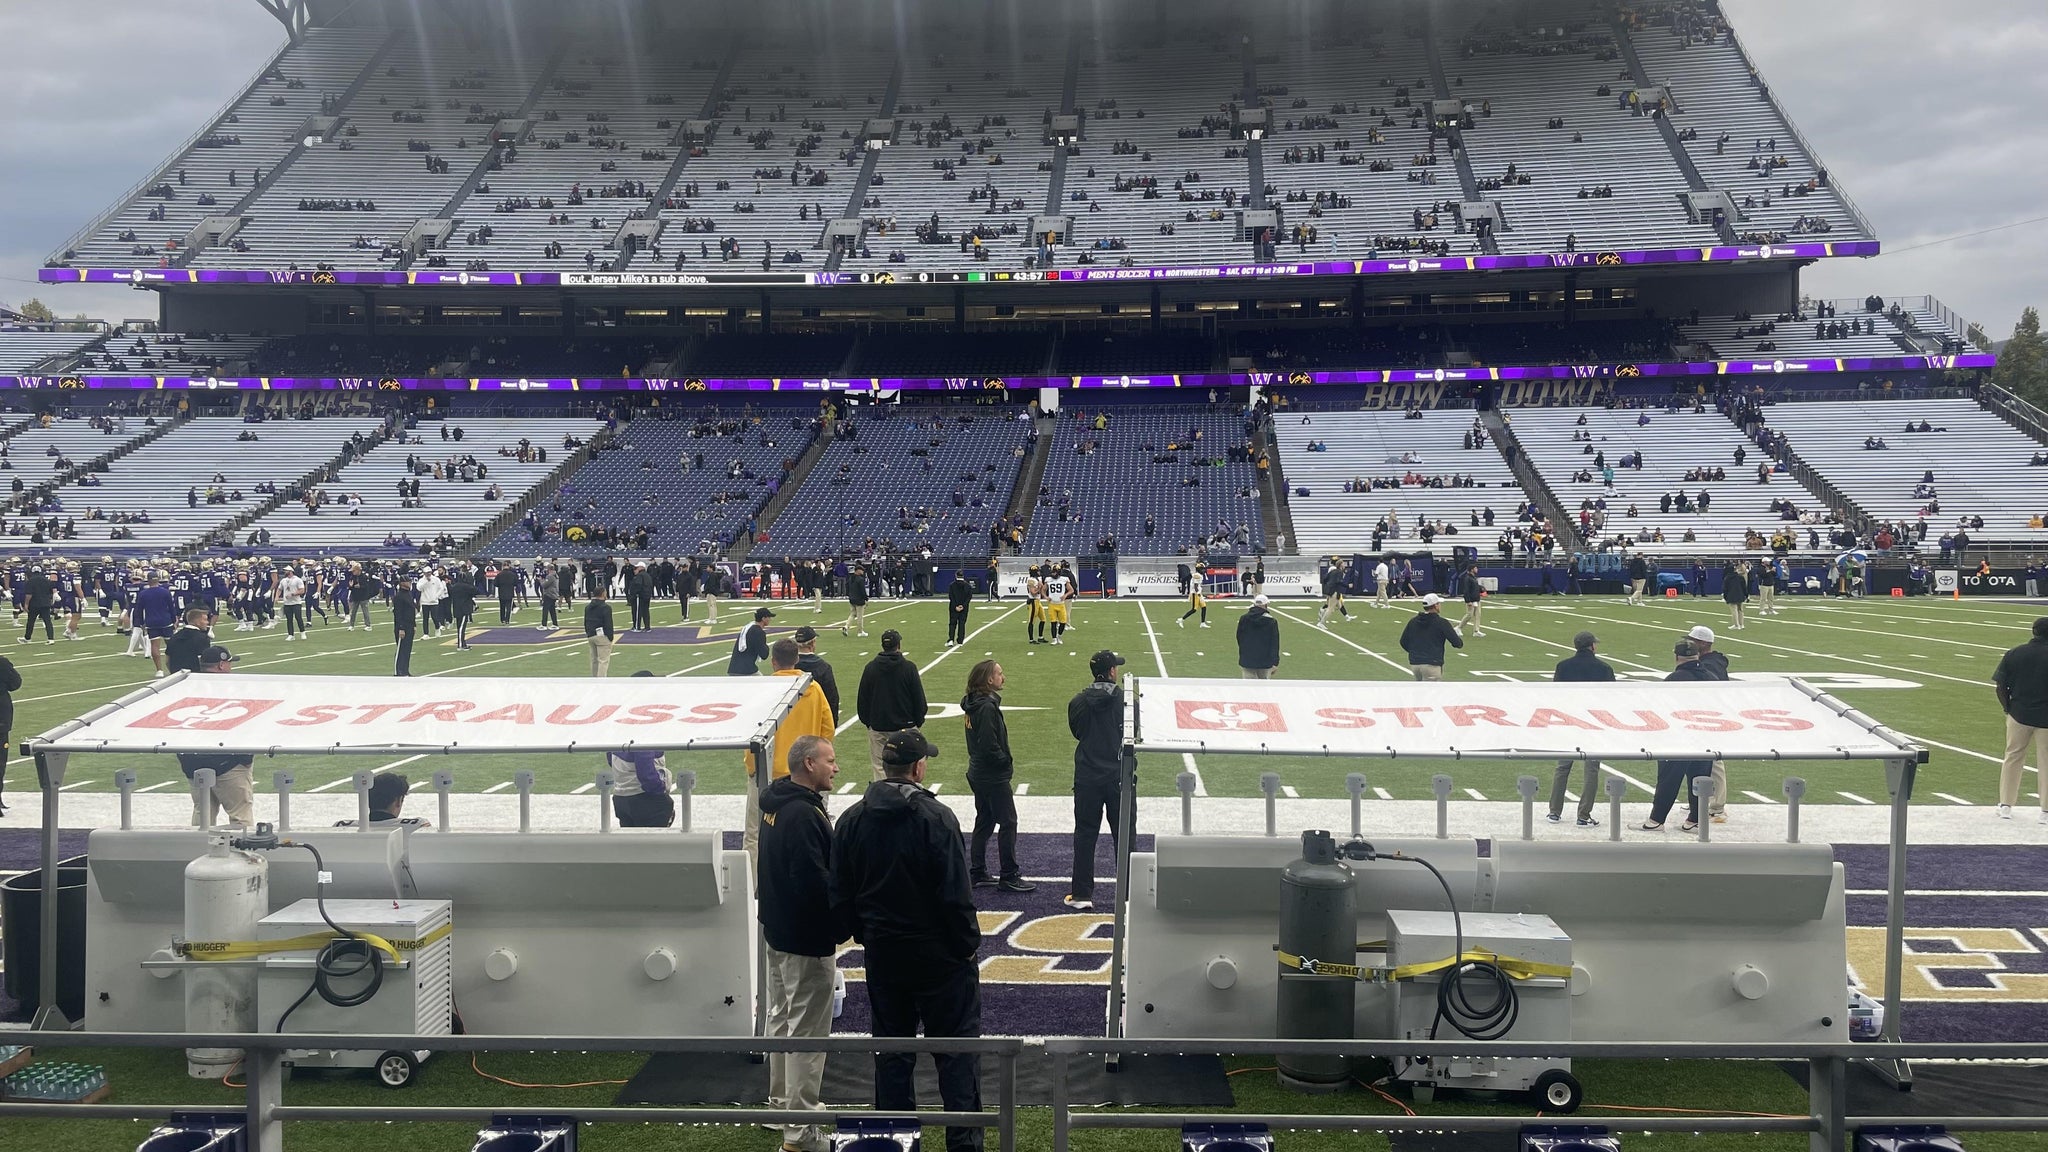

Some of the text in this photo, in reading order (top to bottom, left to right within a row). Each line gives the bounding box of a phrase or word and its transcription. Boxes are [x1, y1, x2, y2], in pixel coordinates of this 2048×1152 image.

[860, 273, 870, 283] 0
[919, 273, 929, 283] 0
[1012, 271, 1044, 281] 43:57
[1087, 270, 1115, 279] MEN'S
[1116, 269, 1150, 278] SOCCER
[1165, 267, 1220, 277] NORTHWESTERN
[1241, 267, 1256, 275] OCT
[588, 275, 620, 285] Jersey
[621, 274, 650, 283] Mike's
[659, 275, 677, 283] sub
[678, 275, 709, 283] above.
[1360, 379, 1617, 411] BOW DOWN
[174, 579, 189, 591] 90
[200, 577, 211, 588] 91
[1136, 576, 1179, 584] HUSKIES
[1962, 576, 2016, 586] TOOTA
[1008, 586, 1018, 594] W
[1049, 583, 1062, 594] 69
[1128, 586, 1138, 594] W
[1302, 586, 1312, 595] W
[279, 700, 740, 728] STRAUSS
[1316, 705, 1815, 732] STRAUSS
